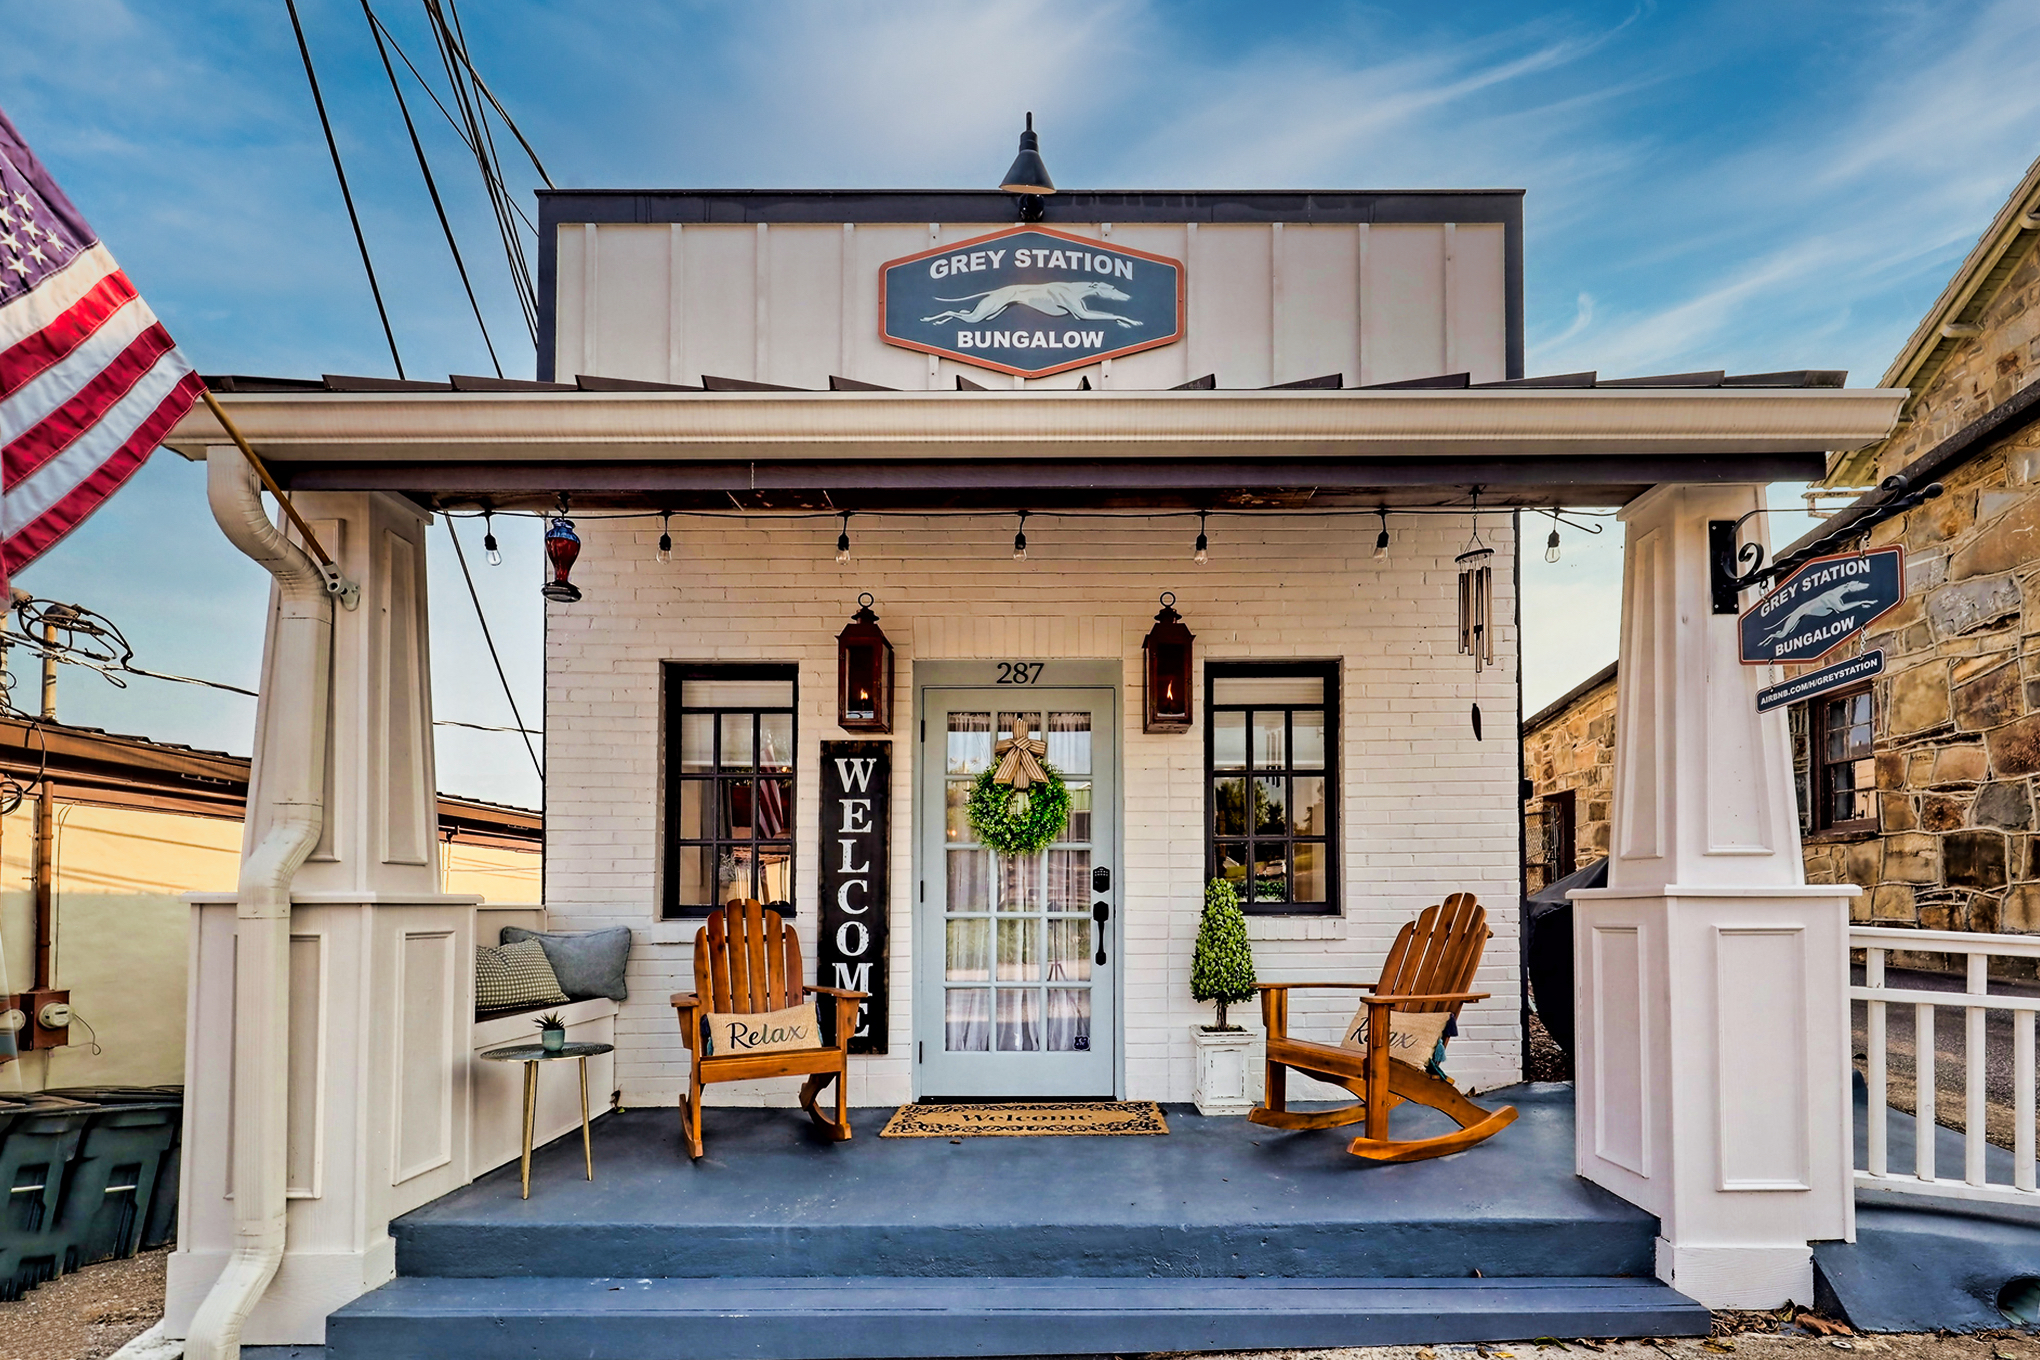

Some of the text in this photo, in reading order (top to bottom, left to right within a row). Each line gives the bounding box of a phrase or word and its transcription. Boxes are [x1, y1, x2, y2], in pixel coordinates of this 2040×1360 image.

[929, 248, 1133, 281] GREY STATION
[957, 330, 1105, 349] BUNGALOW
[1760, 558, 1871, 618] GREY STATION
[1775, 615, 1856, 657] BUNGALOW
[996, 662, 1045, 685] 287
[1760, 658, 1878, 706] AIRBNB.COM/H/GREYSTATION
[725, 1021, 809, 1050] Relax
[1350, 1016, 1419, 1049] Rax
[961, 1113, 1094, 1123] Welcome
